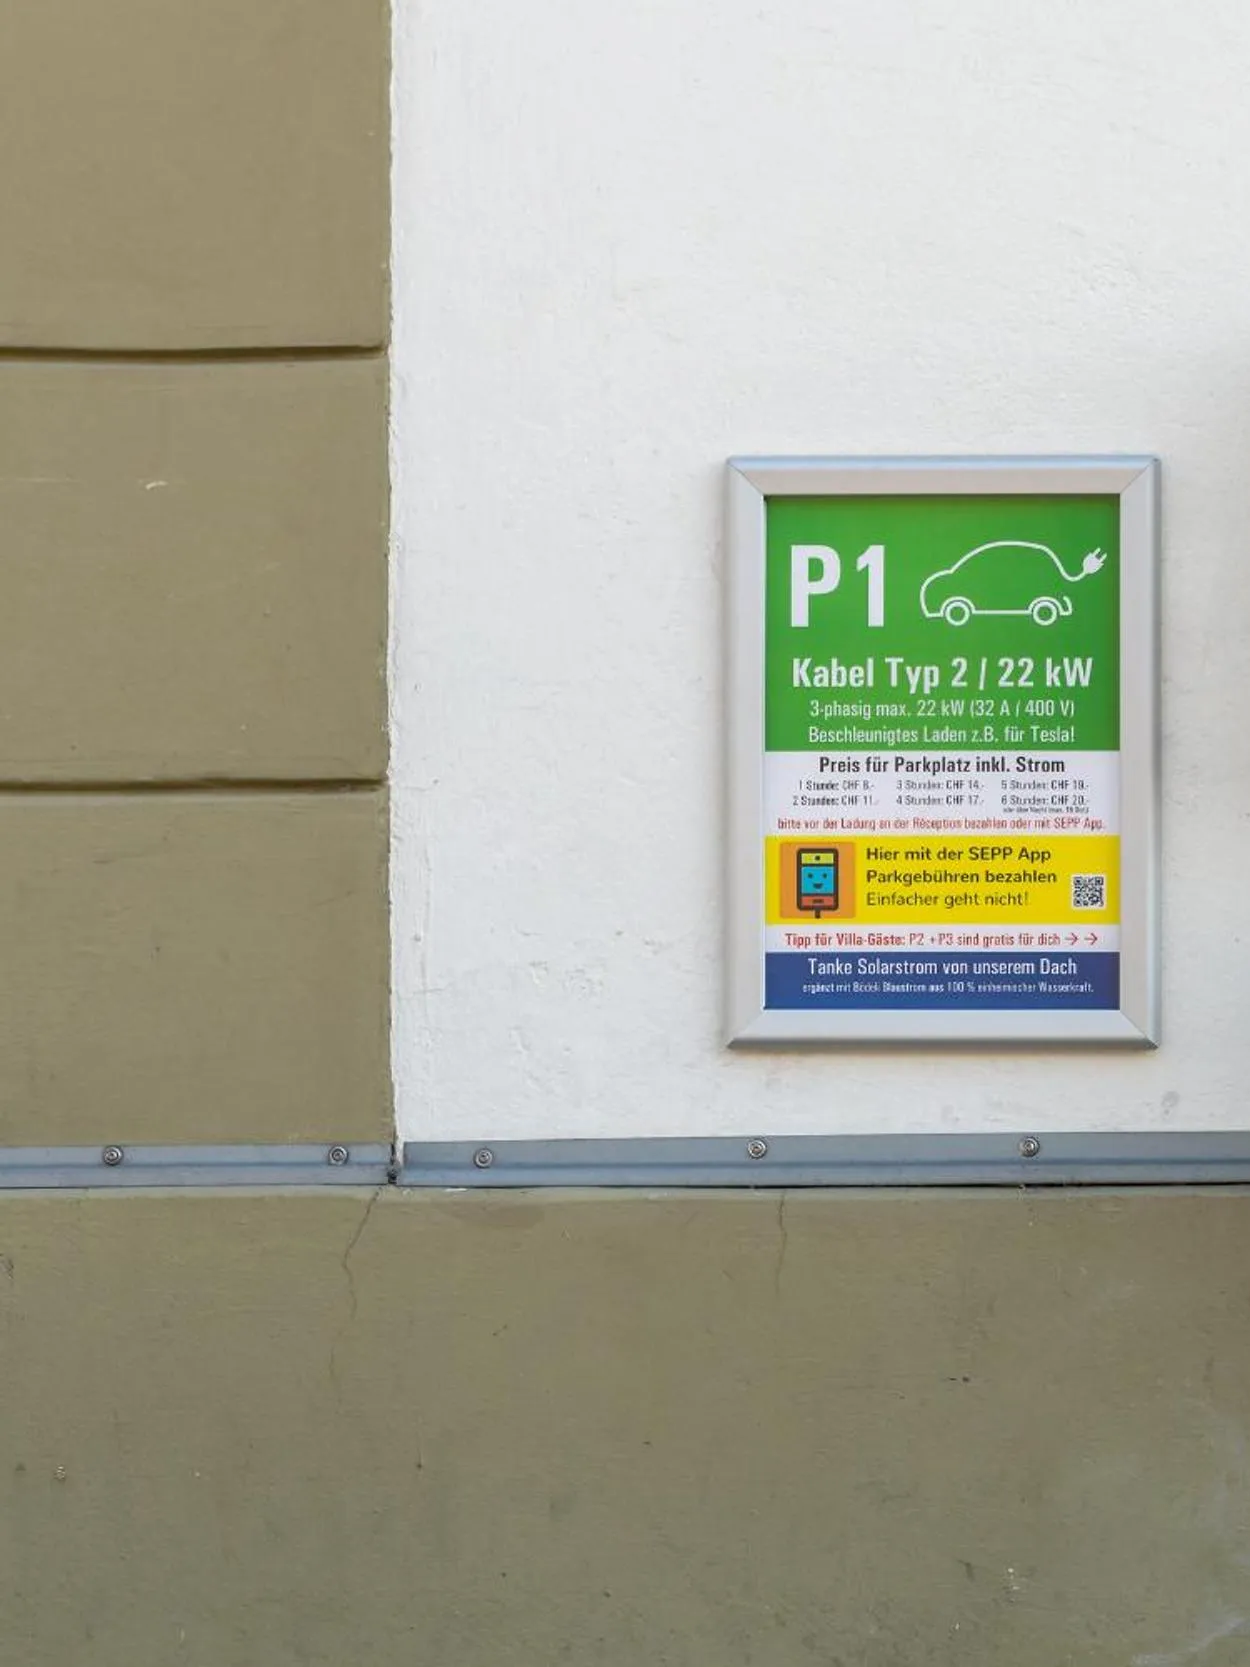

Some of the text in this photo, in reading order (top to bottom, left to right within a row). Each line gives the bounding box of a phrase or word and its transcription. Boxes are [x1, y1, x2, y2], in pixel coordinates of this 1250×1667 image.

[792, 656, 1093, 695] Kabel Typ 2 / 22 kW
[810, 699, 1075, 721] 3-phasig max. 22 kW (32 A / 400 V)
[808, 725, 1076, 744] Beschleunigtes Laden z.B. für Tesla!
[819, 756, 1065, 776] Preis für Parkplatz inkl. Strom
[842, 780, 860, 791] CHF
[896, 780, 903, 790] 3
[946, 780, 965, 791] CHF
[1001, 780, 1008, 790] 5
[1051, 780, 1070, 790] CHF
[793, 795, 799, 806] 2
[841, 795, 860, 806] CHF
[896, 795, 903, 805] 4
[946, 795, 965, 806] CHF
[1051, 795, 1070, 806] CHF
[778, 818, 801, 830] bitte
[804, 820, 819, 830] vor
[823, 818, 838, 830] der
[841, 818, 876, 832] Ladung
[880, 820, 891, 830] an
[894, 818, 909, 830] der
[964, 817, 1007, 830] bezahlen
[1010, 818, 1032, 830] oder
[1035, 818, 1050, 830] mit
[1053, 818, 1080, 830] SEPP
[866, 846, 1052, 864] Hier mit der SEPP App
[866, 869, 1058, 885] Parkgebühren bezahlen
[866, 891, 1030, 908] Einfacher geht nicht!
[785, 932, 811, 948] Tipp
[815, 932, 833, 946] für
[835, 932, 906, 946] Villa-Gäste:
[909, 932, 925, 946] P2
[957, 932, 979, 946] sind
[982, 933, 1015, 949] gratis
[1018, 932, 1035, 946] für
[1038, 932, 1061, 946] dich
[807, 957, 1078, 975] Tanke Solarstrom von unserem Dach
[948, 981, 965, 993] 100
